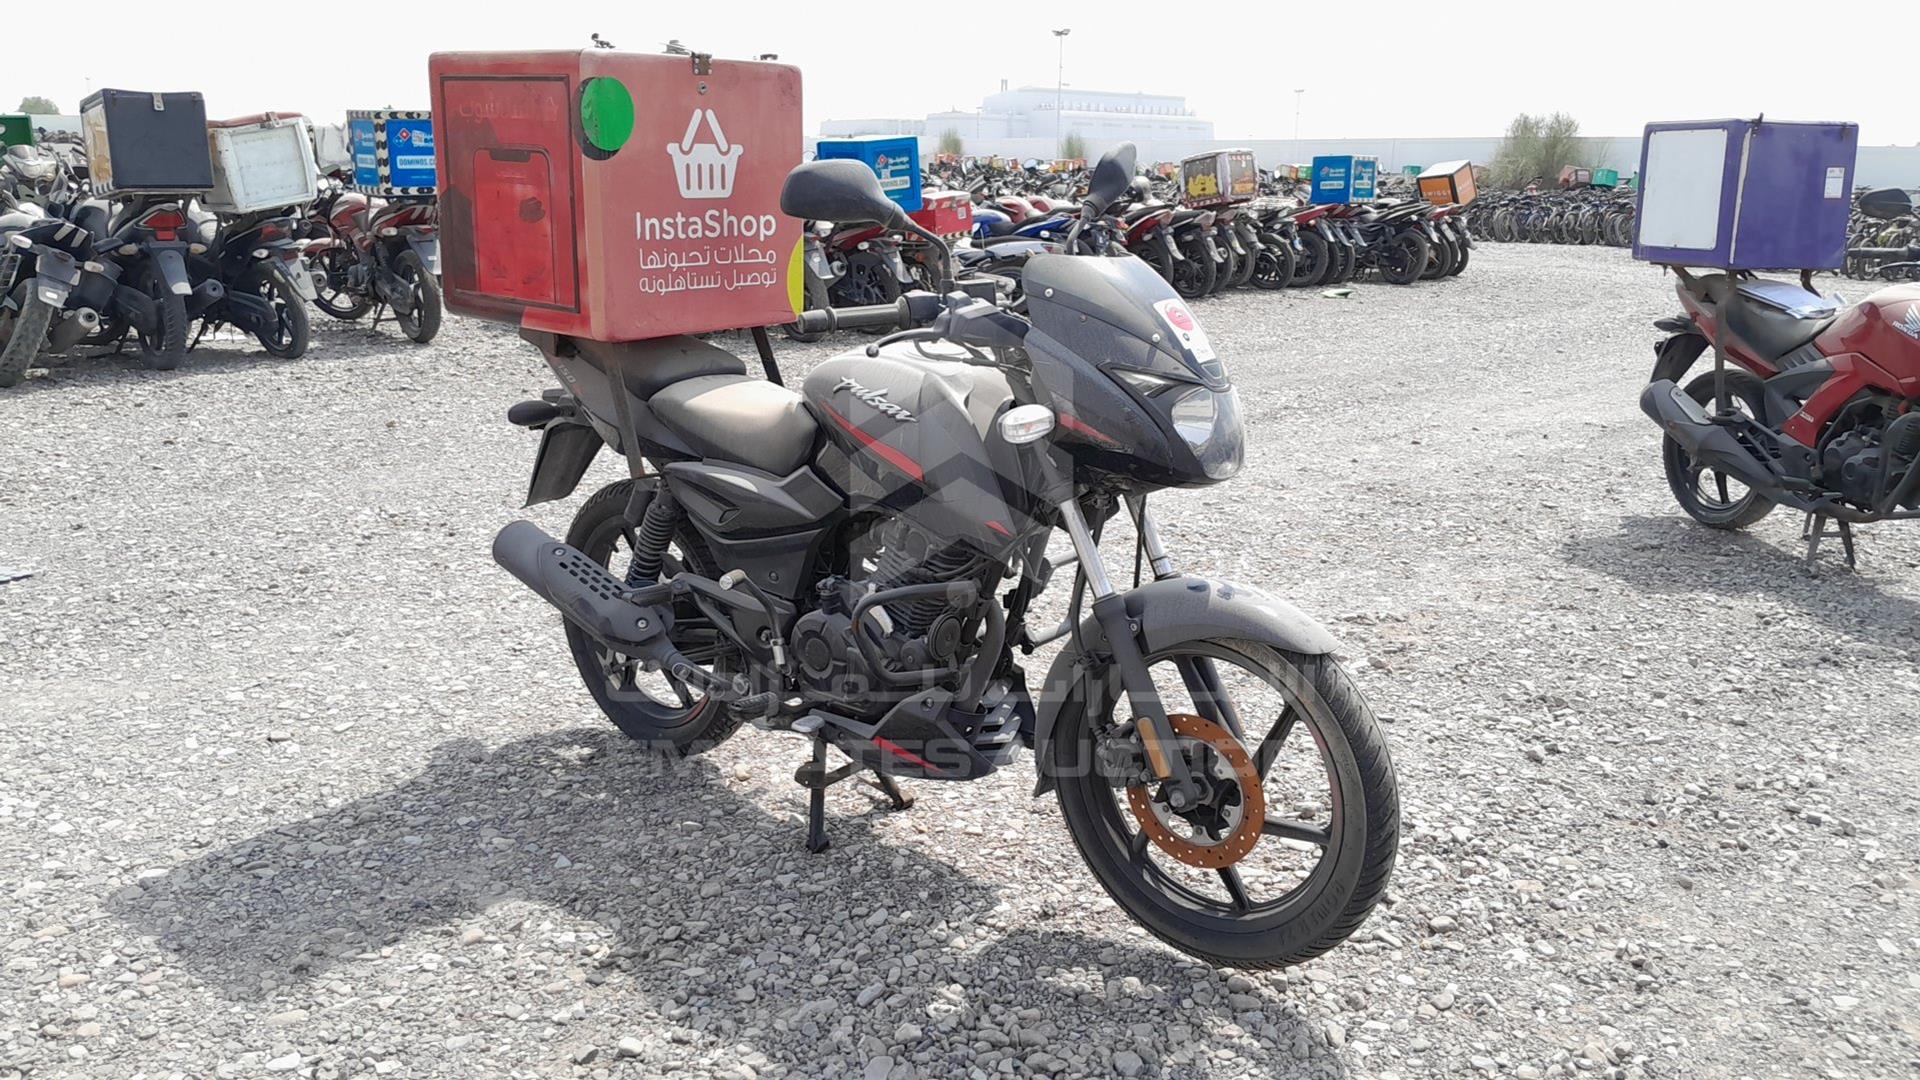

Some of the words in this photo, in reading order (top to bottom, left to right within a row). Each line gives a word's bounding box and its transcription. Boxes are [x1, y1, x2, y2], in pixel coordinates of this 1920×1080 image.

[636, 208, 777, 242] InstaShop
[639, 245, 710, 272] تحبونها
[714, 243, 777, 265] محلات
[639, 271, 721, 296] تستاهلونه
[724, 268, 777, 291] توصيل
[833, 376, 917, 422] Pulsar
